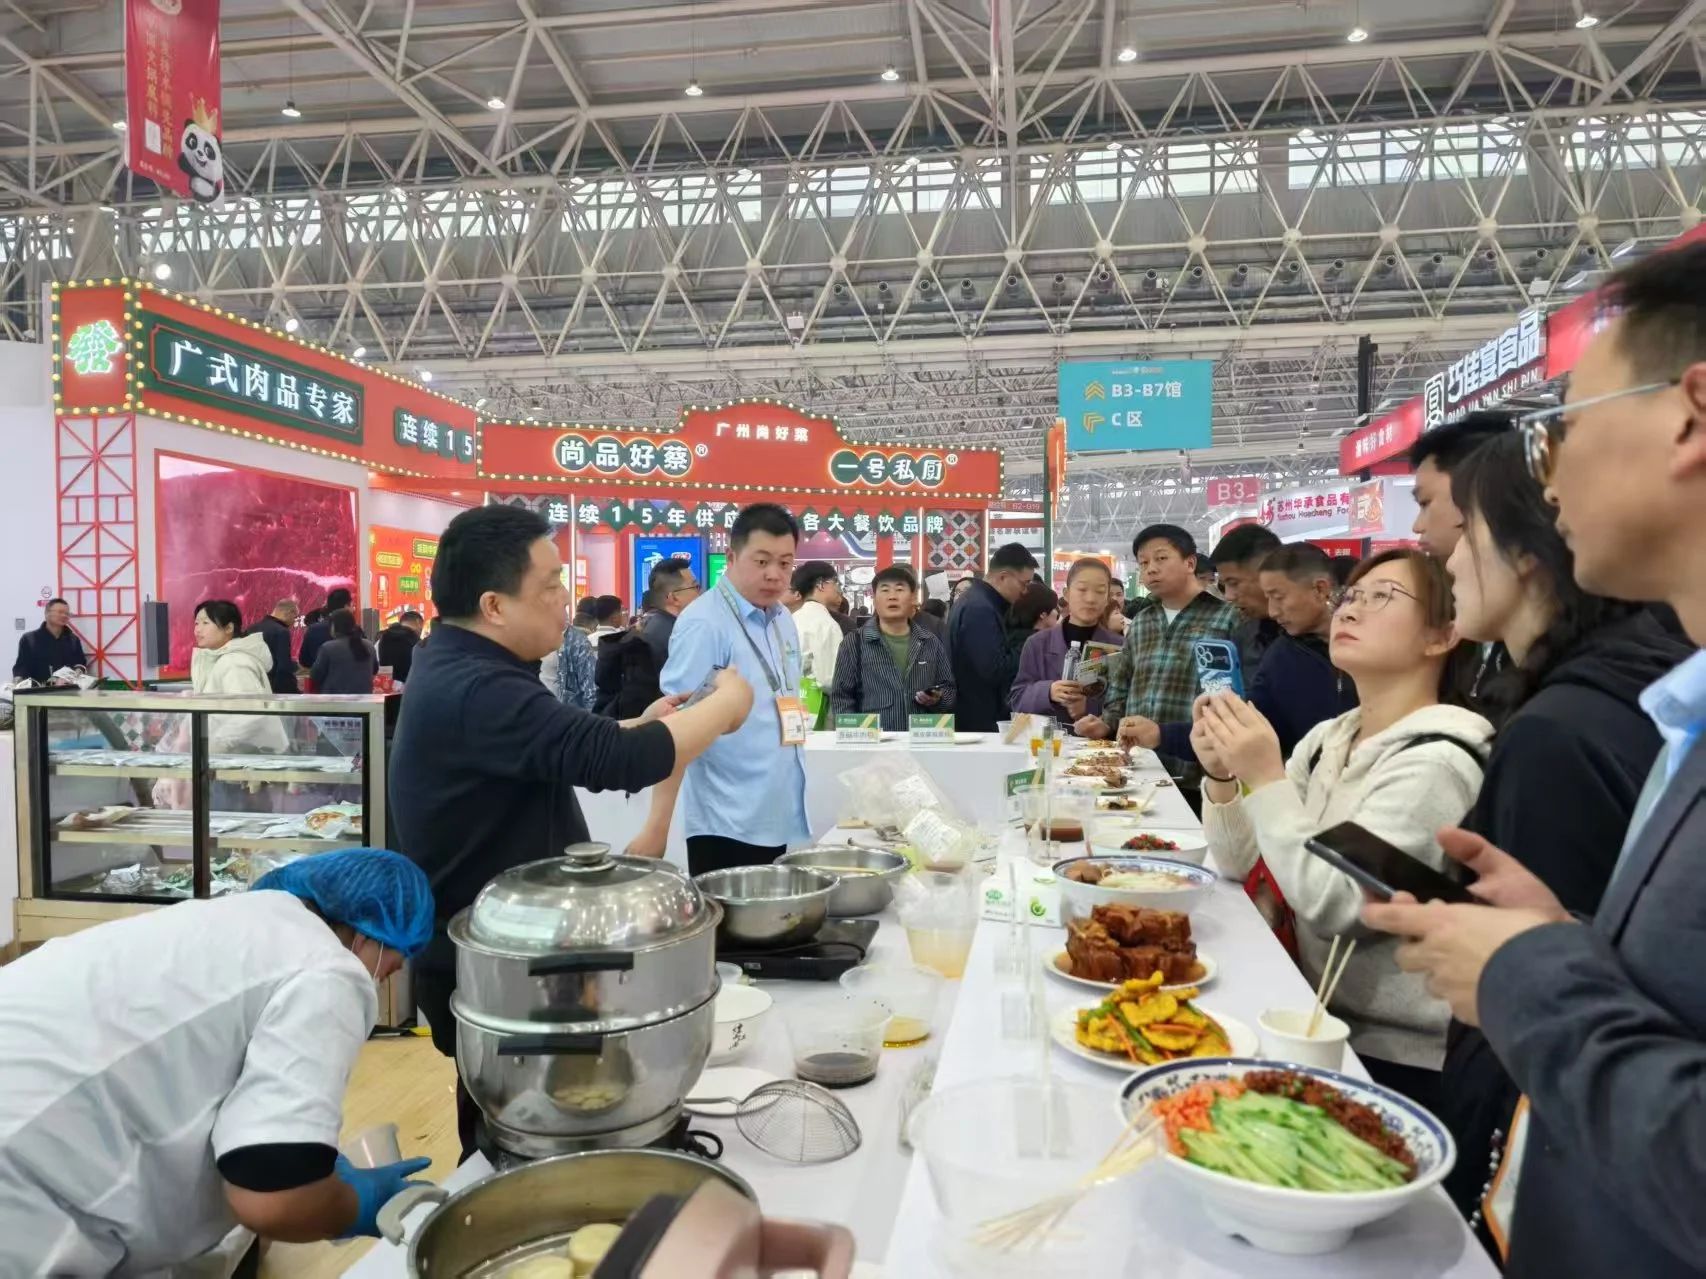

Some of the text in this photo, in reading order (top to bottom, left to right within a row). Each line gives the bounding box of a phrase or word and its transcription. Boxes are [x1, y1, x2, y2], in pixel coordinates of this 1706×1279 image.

[168, 340, 354, 424] 广式肉品专家
[1112, 381, 1182, 397] B3-B7馆
[1502, 378, 1517, 396] SHI
[1521, 367, 1538, 388] PIN
[1112, 411, 1142, 427] C 区
[401, 414, 473, 456] 连续15
[561, 440, 688, 470] 尚品好蔡
[837, 458, 942, 481] 一号私厨
[1217, 482, 1245, 501] B3
